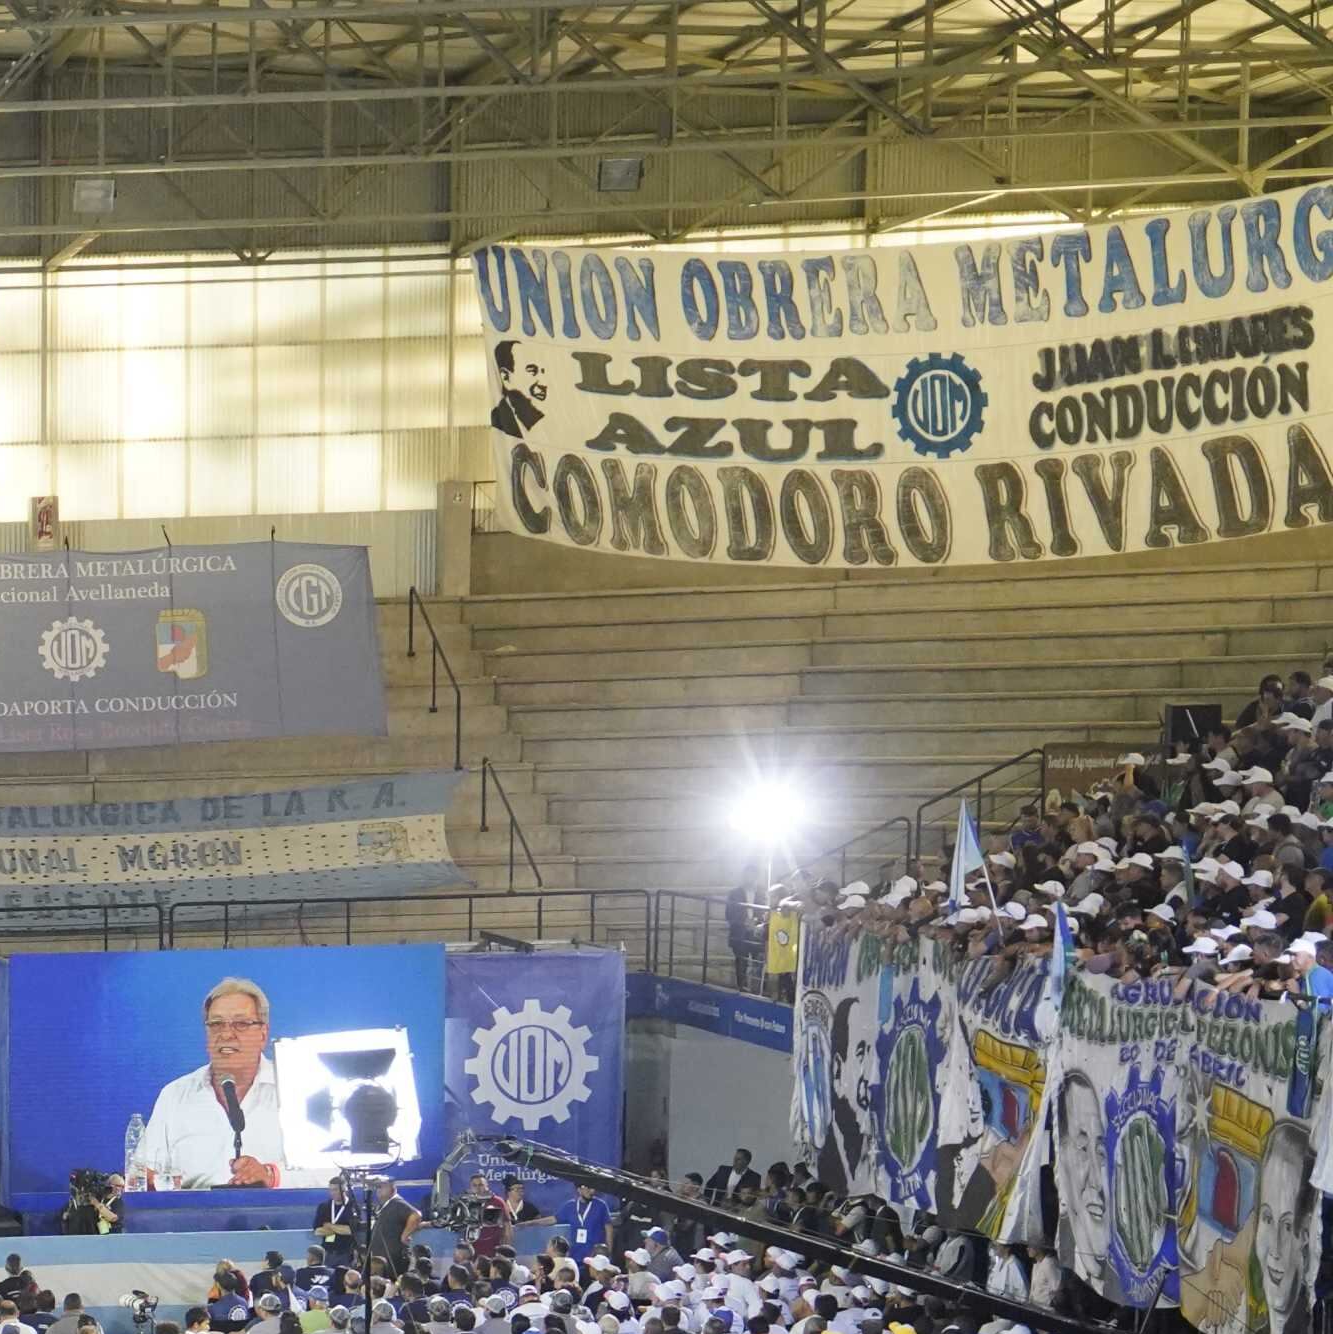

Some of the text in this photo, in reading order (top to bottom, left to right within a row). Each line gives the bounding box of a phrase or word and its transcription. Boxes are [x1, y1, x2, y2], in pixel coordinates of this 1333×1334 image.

[474, 245, 661, 341] UNION
[680, 250, 937, 343] OBRERA
[572, 351, 890, 402] LISTA
[1032, 335, 1142, 392] JUAN
[1029, 355, 1310, 450] CONDUCCIÓN
[585, 412, 884, 461] AZUL
[511, 422, 1333, 566] COMODORO RIVADA
[66, 582, 171, 601] Avellaneda
[75, 555, 237, 578] METALÚRGICA
[95, 691, 238, 714] CONDUCCIÓN
[200, 796, 247, 822] DE
[261, 791, 306, 818] LA
[116, 840, 244, 873] MORON
[493, 1027, 570, 1102] UOM
